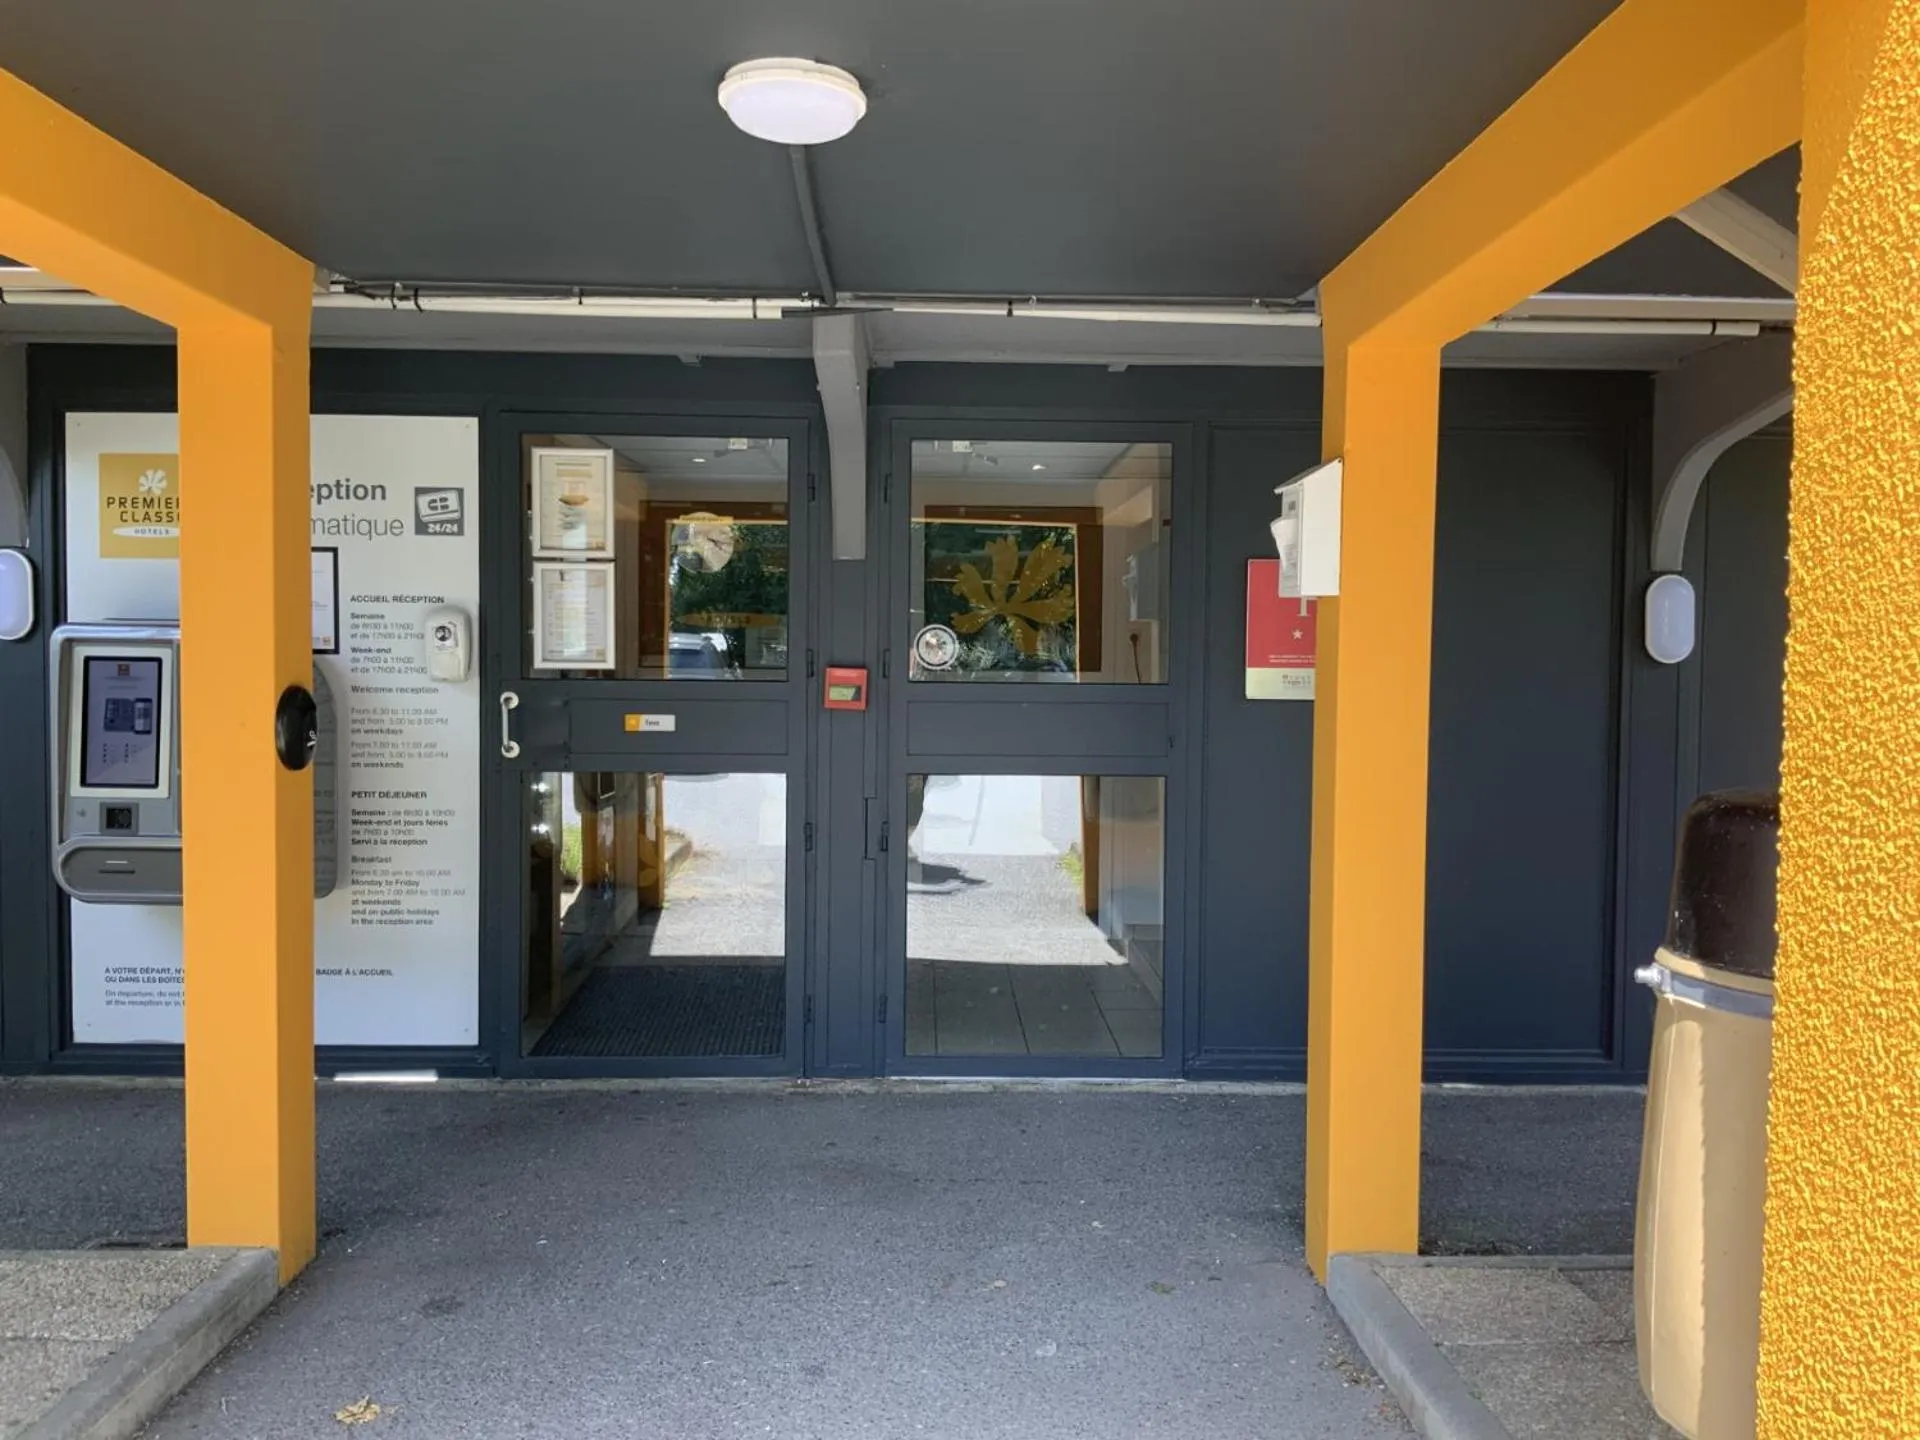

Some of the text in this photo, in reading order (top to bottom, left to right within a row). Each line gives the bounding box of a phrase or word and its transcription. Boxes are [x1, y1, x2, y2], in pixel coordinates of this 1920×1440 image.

[310, 478, 386, 505] ption
[107, 496, 179, 509] PREMIE
[120, 511, 179, 523] CLASS
[310, 514, 404, 541] matique
[427, 523, 458, 533] 24/24
[350, 595, 444, 603] ACCUEIL RÉCEPTION
[351, 686, 439, 694] Welcome reception
[352, 790, 427, 798] PETIT DÉJEUNER
[403, 819, 424, 827] jours
[352, 838, 372, 846] Servi
[351, 879, 382, 887] Monday
[395, 879, 420, 887] Friday
